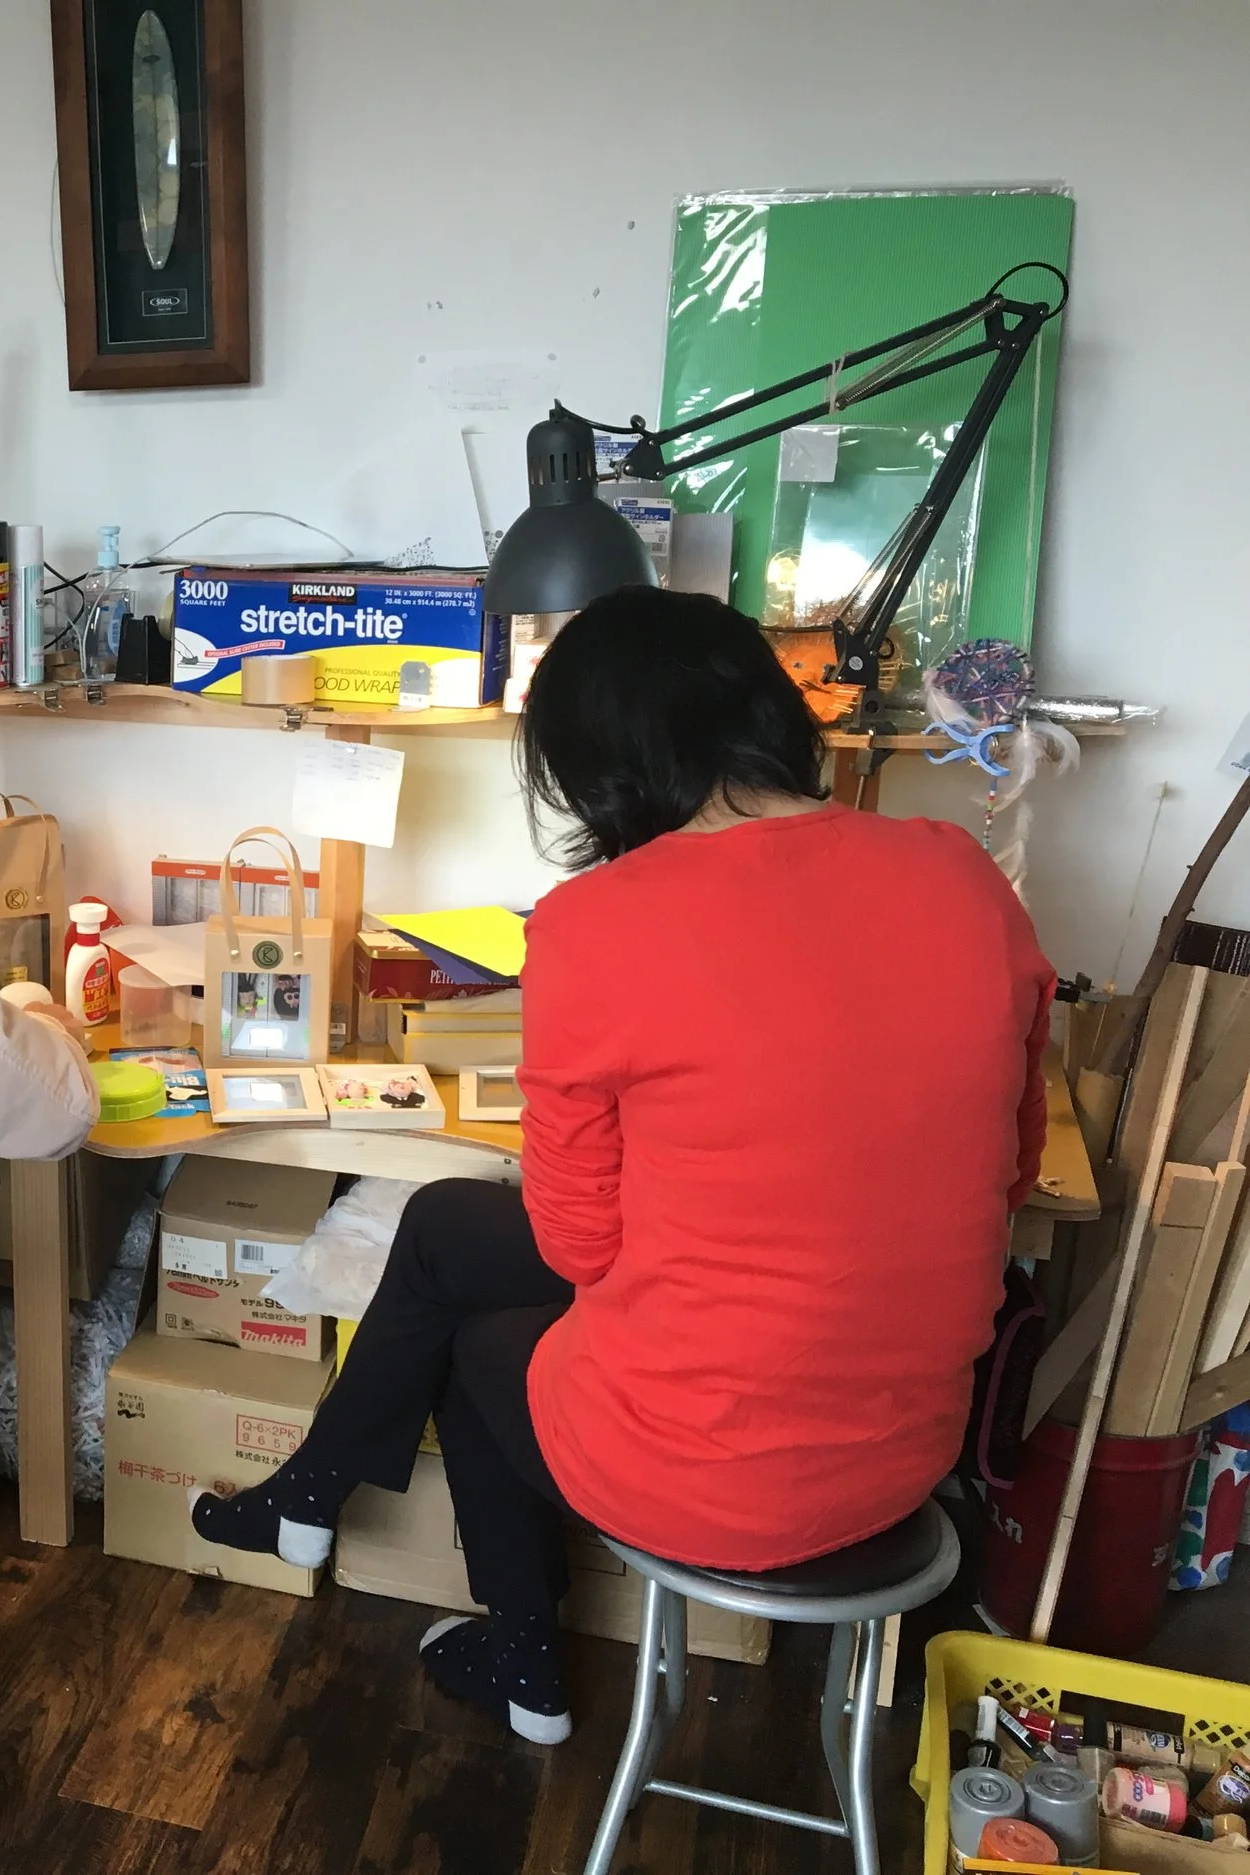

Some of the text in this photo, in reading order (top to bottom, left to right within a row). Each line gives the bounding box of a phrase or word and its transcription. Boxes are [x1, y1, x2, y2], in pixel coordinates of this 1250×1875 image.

[179, 579, 229, 600] 3000
[292, 584, 355, 597] KIRKLAND
[435, 591, 452, 599] (3000
[240, 604, 403, 639] stretch-tite
[324, 667, 400, 677] PROFESSIONAL QUALITY
[314, 676, 350, 692] OOD
[252, 1311, 307, 1323] 株式会社 マキタ
[235, 1450, 270, 1465] 株式会社
[117, 1459, 197, 1488] 梅干茶づけ
